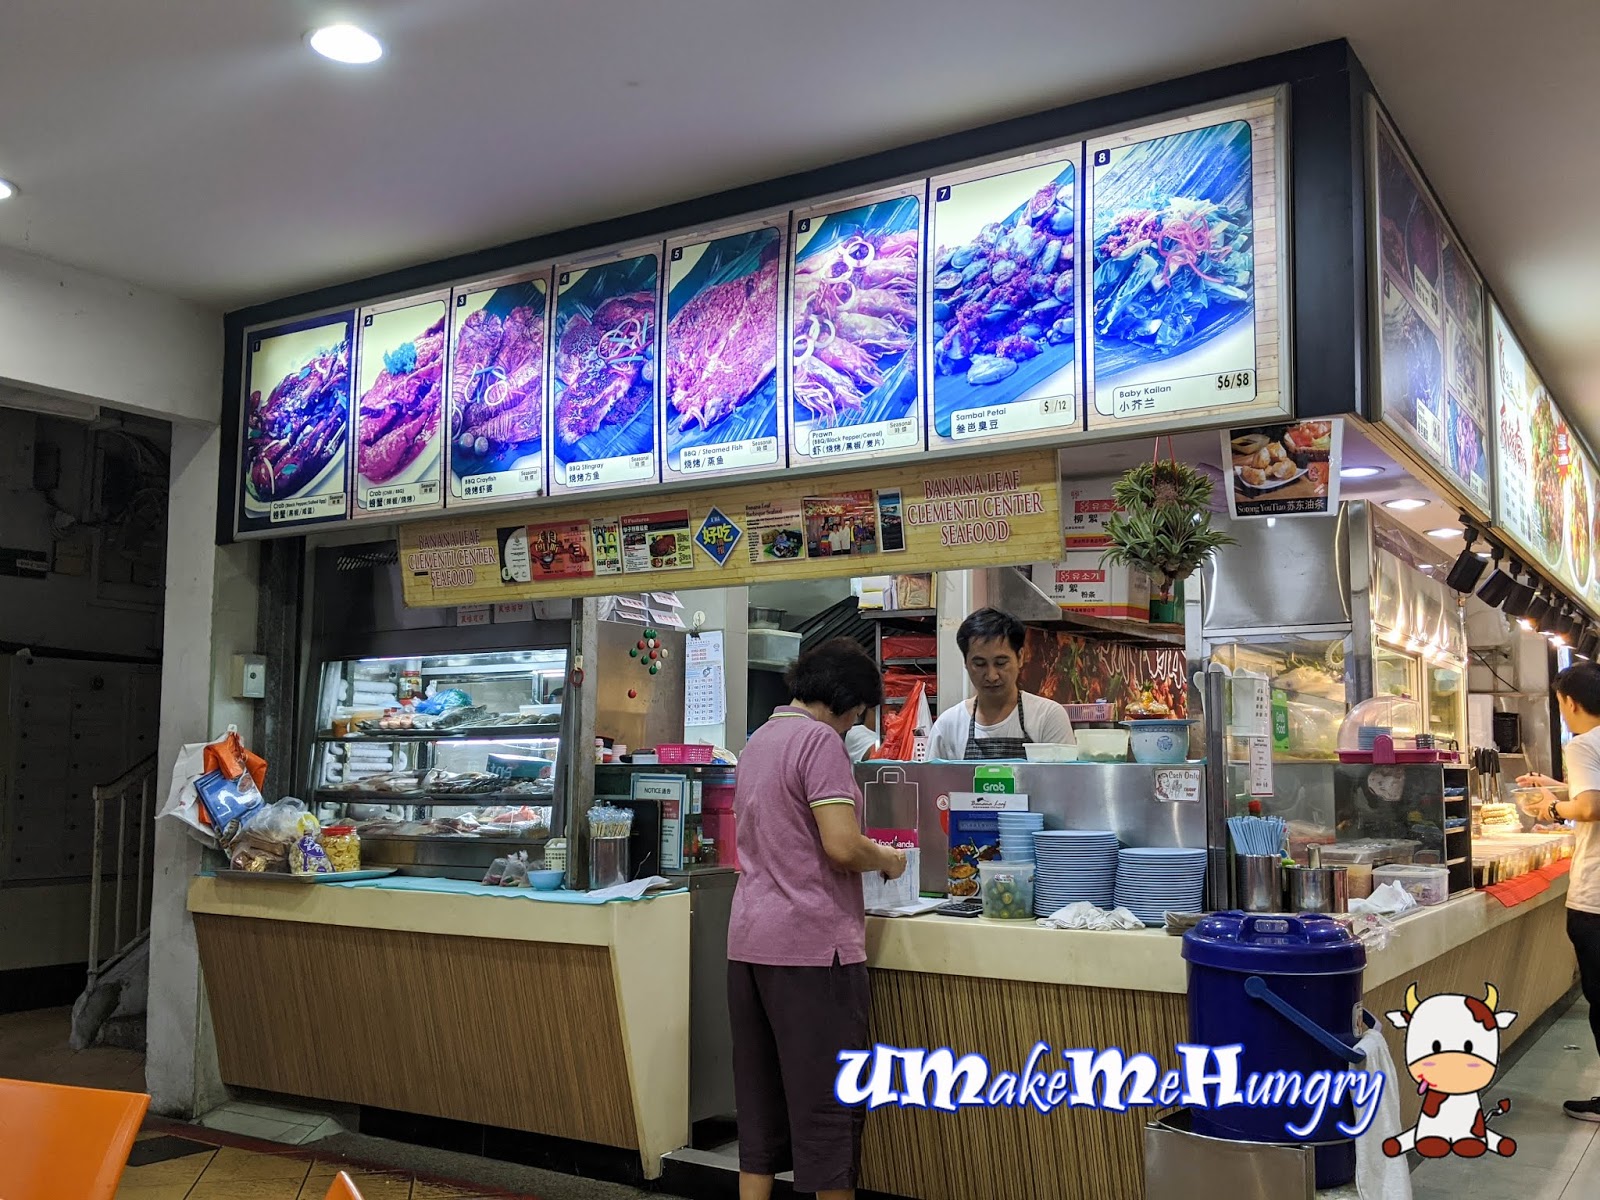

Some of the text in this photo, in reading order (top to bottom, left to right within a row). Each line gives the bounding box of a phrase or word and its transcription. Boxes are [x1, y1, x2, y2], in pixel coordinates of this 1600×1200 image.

[1098, 152, 1106, 164] 8
[939, 188, 947, 199] 7
[801, 220, 808, 231] 6
[674, 249, 680, 259] 5
[561, 273, 568, 284] 4
[460, 296, 464, 305] 3
[366, 317, 371, 326] 2
[1217, 372, 1249, 389] $6/$8
[1119, 385, 1172, 399] Baby Kailan
[1119, 398, 1155, 413] 小芥兰
[956, 407, 1007, 421] Sambal Petai
[889, 419, 912, 428] Seasonal
[812, 431, 833, 439] Prawn
[752, 439, 772, 447] Seasonal
[702, 446, 730, 455] Steamed
[581, 463, 604, 472] Stingray
[476, 475, 497, 484] Crayfish
[924, 470, 1020, 500] BANANA LEAF
[907, 492, 1044, 525] CLEMENTI CENTER
[1237, 505, 1260, 514] Sotong
[702, 523, 733, 545] 好吃
[941, 520, 1010, 546] SEAFOOD
[418, 528, 480, 550] BANANA LEAF
[408, 549, 457, 570] CLEMENTI
[457, 546, 497, 566] CENTER
[430, 568, 475, 588] SEAFOOD
[1072, 572, 1100, 581] 유소기
[1168, 770, 1200, 780] Cash Only
[982, 781, 1006, 792] Grab
[994, 800, 1007, 809] Leaf
[878, 838, 915, 848] foodanda
